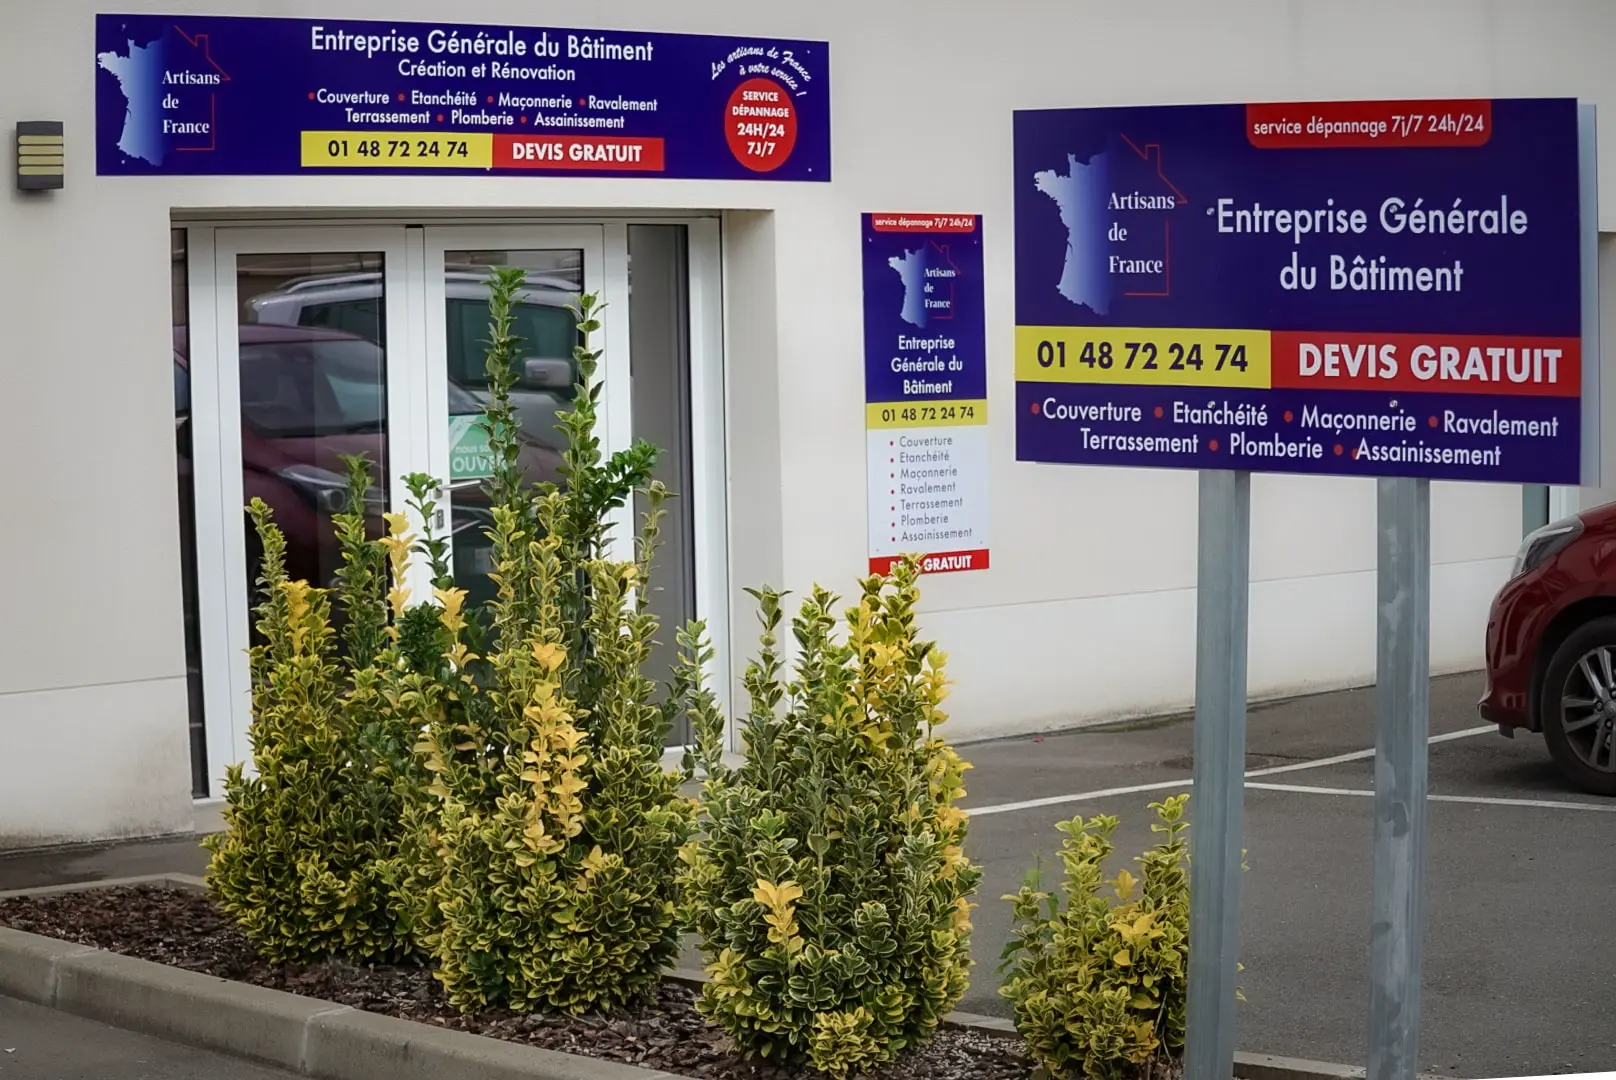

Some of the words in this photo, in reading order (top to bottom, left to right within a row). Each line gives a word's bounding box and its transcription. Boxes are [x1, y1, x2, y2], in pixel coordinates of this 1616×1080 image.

[312, 26, 419, 59] Entreprise
[427, 28, 526, 58] Générale
[534, 33, 560, 57] du
[568, 35, 653, 61] Bâtiment
[399, 59, 465, 77] Création
[472, 63, 486, 78] et
[492, 63, 575, 81] Rénovation
[710, 60, 726, 80] Les
[728, 47, 764, 62] artisans
[767, 47, 779, 60] de
[782, 51, 812, 82] France
[162, 69, 220, 85] Artisans
[739, 63, 746, 76] à
[748, 63, 770, 75] votre
[771, 68, 799, 90] service
[162, 94, 179, 109] de
[317, 89, 389, 104] Couverture
[411, 88, 477, 107] Etanchéité
[499, 93, 572, 110] Maçonnerie
[589, 95, 657, 112] Ravalement
[743, 90, 779, 102] SERVICE
[345, 108, 429, 124] Terrassement
[451, 109, 514, 126] Plomberie
[534, 112, 625, 129] Assainissement
[732, 104, 789, 118] DÉPANNAGE
[162, 119, 209, 134] France
[737, 123, 785, 138] 24H/24
[1253, 118, 1303, 136] service
[1307, 115, 1387, 138] dépannage
[1391, 115, 1423, 138] 7j/7
[1428, 113, 1484, 136] 24h/24
[328, 141, 348, 157] 01
[357, 141, 380, 157] 48
[388, 141, 410, 157] 72
[417, 141, 440, 157] 24
[447, 141, 468, 157] 74
[512, 142, 564, 161] DEVIS
[568, 144, 642, 162] GRATUIT
[747, 142, 776, 156] 7J/7
[1108, 191, 1175, 210] Artisans
[898, 218, 933, 227] dépannage
[934, 218, 948, 228] 7j/7
[949, 218, 972, 227] 24h/24
[1217, 197, 1367, 244] Entreprise
[1379, 194, 1528, 235] Générale
[1108, 222, 1127, 241] de
[924, 268, 955, 278] Artisans
[1109, 255, 1163, 275] France
[1280, 251, 1316, 292] du
[1330, 254, 1463, 293] Bâtiment
[924, 283, 933, 293] de
[925, 299, 950, 308] France
[899, 335, 955, 353] Entreprise
[891, 355, 945, 372] Générale
[949, 356, 963, 371] du
[1037, 340, 1066, 368] 01
[1079, 341, 1113, 368] 48
[1124, 341, 1158, 369] 72
[1168, 342, 1203, 370] 24
[1215, 343, 1247, 372] 74
[1299, 342, 1398, 378] DEVIS
[1410, 345, 1562, 383] GRATUIT
[903, 379, 952, 394] Bâtiment
[882, 409, 896, 421] 01
[901, 408, 916, 421] 48
[921, 408, 936, 420] 72
[941, 407, 955, 419] 24
[960, 406, 974, 418] 74
[1043, 398, 1141, 422] Couverture
[1173, 400, 1268, 426] Etanchéité
[1301, 405, 1416, 435] Maçonnerie
[1444, 410, 1559, 436] Ravalement
[900, 436, 952, 447] Couverture
[1080, 428, 1198, 454] Terrassement
[1230, 432, 1323, 458] Plomberie
[1356, 437, 1500, 466] Assainissement
[900, 450, 950, 463] Etanchéité
[900, 466, 958, 481] Maçonnerie
[901, 482, 955, 495] Ravalement
[900, 497, 963, 511] Terrassement
[901, 513, 948, 526] Plomberie
[901, 528, 972, 542] Assainissement
[924, 555, 972, 570] GRATUIT
